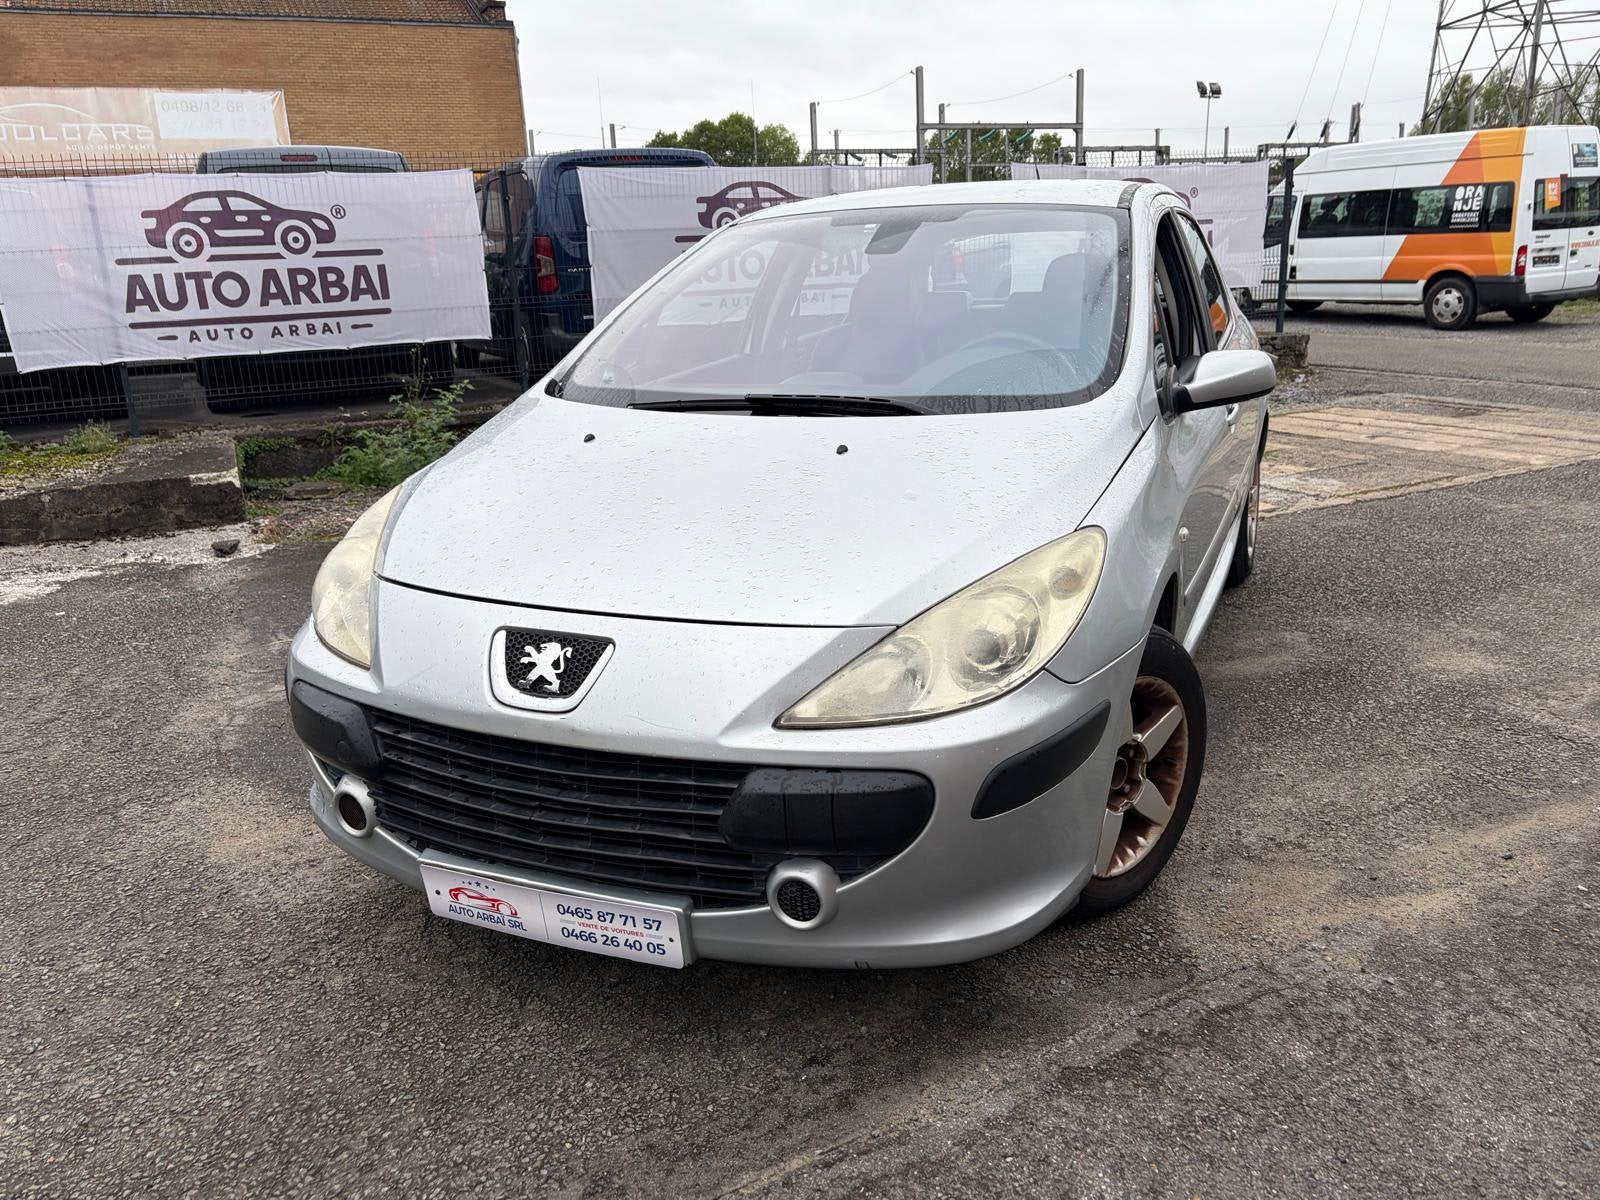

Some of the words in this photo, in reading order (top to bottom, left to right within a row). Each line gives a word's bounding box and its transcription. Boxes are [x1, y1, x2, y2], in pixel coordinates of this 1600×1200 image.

[126, 271, 250, 314] AUTO
[260, 264, 390, 307] ARBAI
[719, 298, 750, 310] AUT
[189, 327, 253, 343] AUTO
[271, 321, 342, 338] ARBAI
[449, 904, 474, 918] AUTO
[507, 918, 528, 931] SRL
[556, 903, 593, 920] 0465
[597, 911, 615, 924] 87
[619, 914, 637, 928] 71
[643, 917, 662, 931] 57
[577, 921, 598, 930] VENTE
[611, 927, 645, 938] VOITURES
[561, 926, 598, 944] 0466
[601, 934, 620, 947] 26
[623, 939, 642, 951] 40
[646, 942, 666, 955] 05
